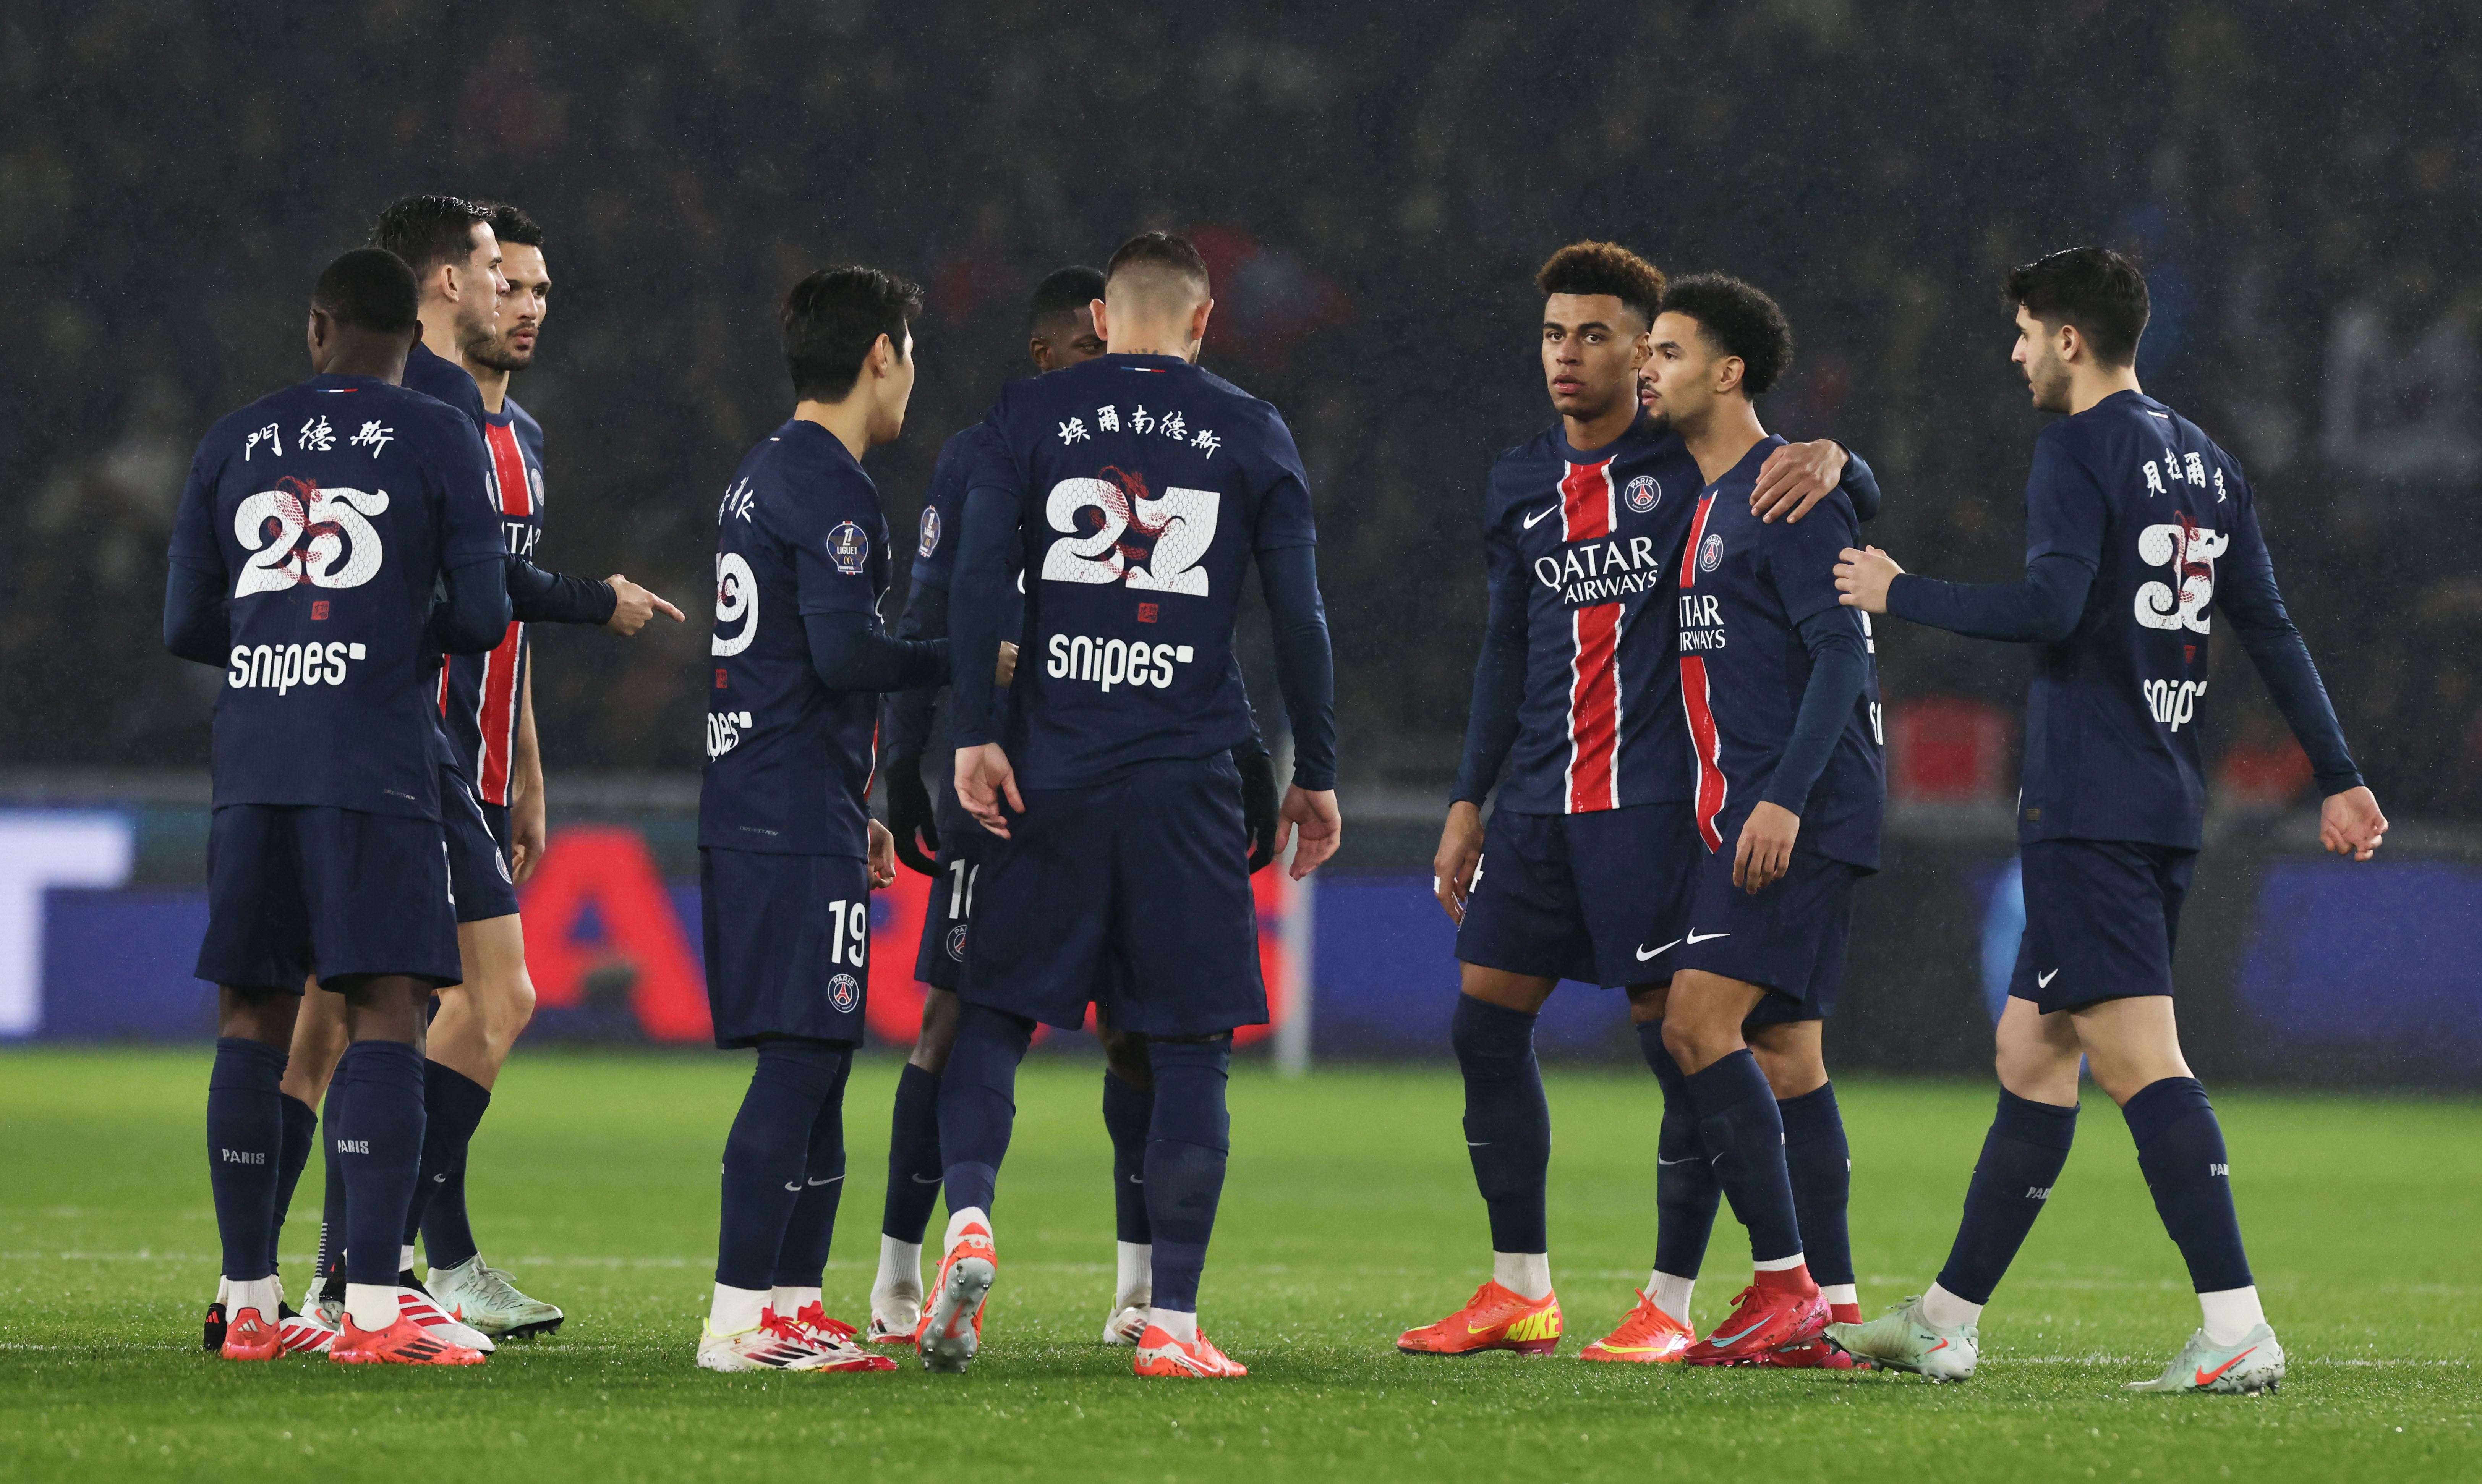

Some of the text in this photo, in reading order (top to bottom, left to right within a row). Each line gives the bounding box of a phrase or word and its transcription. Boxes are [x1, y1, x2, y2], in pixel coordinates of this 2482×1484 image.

[246, 415, 394, 461] 門德斯
[1058, 405, 1221, 460] 埃爾南德斯
[1630, 477, 1654, 489] PARIS
[2143, 448, 2227, 503] 貝拉爾多
[234, 487, 389, 599] 25
[1041, 477, 1221, 597] 27
[1534, 536, 1659, 592] QATAR
[1706, 536, 1721, 546] PARIS
[711, 552, 759, 657] 9
[1564, 570, 1657, 604] AIRWAYS
[2134, 524, 2229, 635] 35
[228, 642, 347, 696] snipes
[1047, 634, 1174, 693] snipes
[829, 900, 866, 968] 19
[833, 975, 855, 987] PARIS
[222, 1148, 265, 1164] PARIS
[337, 1139, 369, 1154] PARIS
[1501, 1304, 1560, 1342] NIKE
